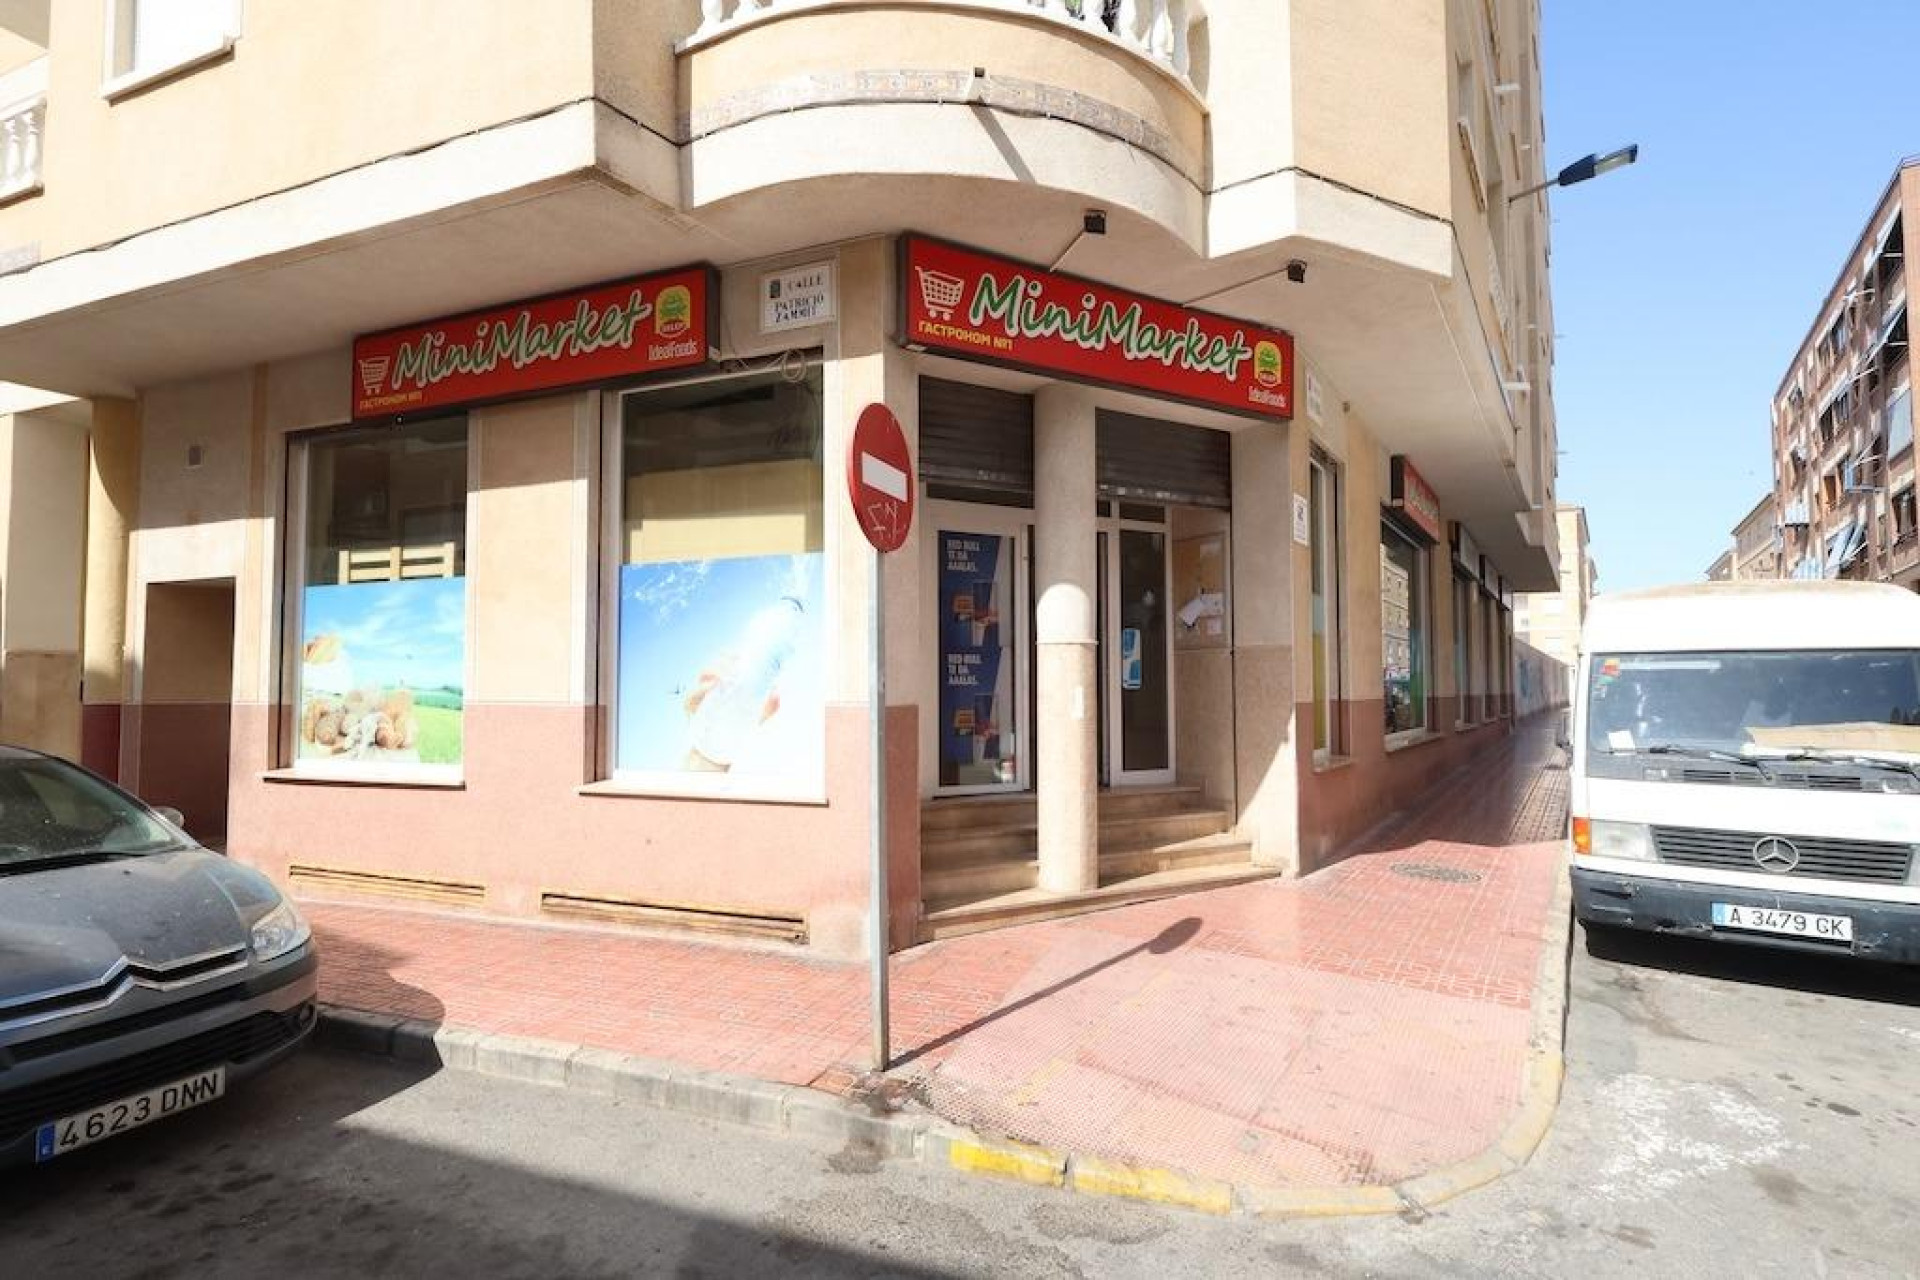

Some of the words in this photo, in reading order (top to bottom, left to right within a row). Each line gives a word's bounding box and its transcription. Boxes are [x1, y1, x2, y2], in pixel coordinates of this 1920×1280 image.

[786, 274, 824, 291] CALLE
[775, 293, 824, 312] PATRICIO
[391, 288, 653, 389] MiniMarket
[918, 320, 990, 346] ГАСТРОНОМ
[969, 272, 1253, 381] MiniMarket
[1730, 907, 1742, 924] A
[1752, 910, 1807, 932] 3479
[1816, 918, 1844, 936] GK
[60, 1095, 150, 1146] 4623
[161, 1073, 217, 1113] DNN
